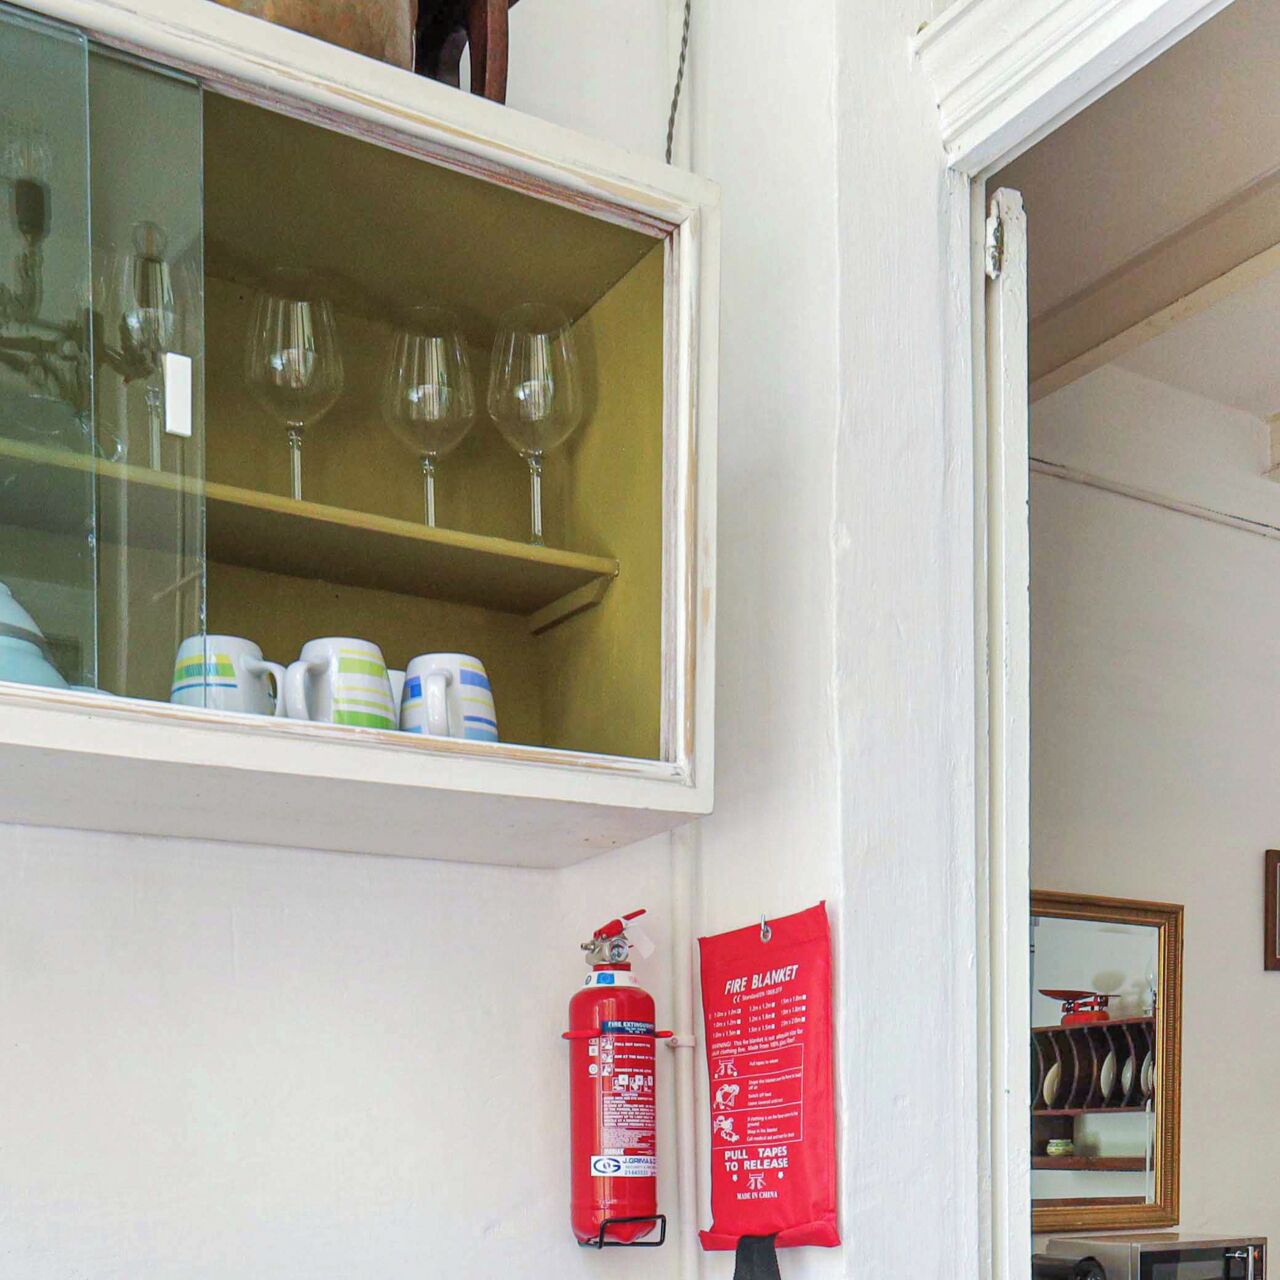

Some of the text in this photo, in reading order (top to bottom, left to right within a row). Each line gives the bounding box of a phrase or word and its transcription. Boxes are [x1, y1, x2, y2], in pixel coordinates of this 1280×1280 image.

[725, 977, 748, 995] FIRE
[751, 964, 798, 989] BLANKET
[724, 1146, 787, 1161] PULL TAPES
[724, 1157, 789, 1172] TO RELEASE
[736, 1191, 778, 1200] MADE IN CHINA
